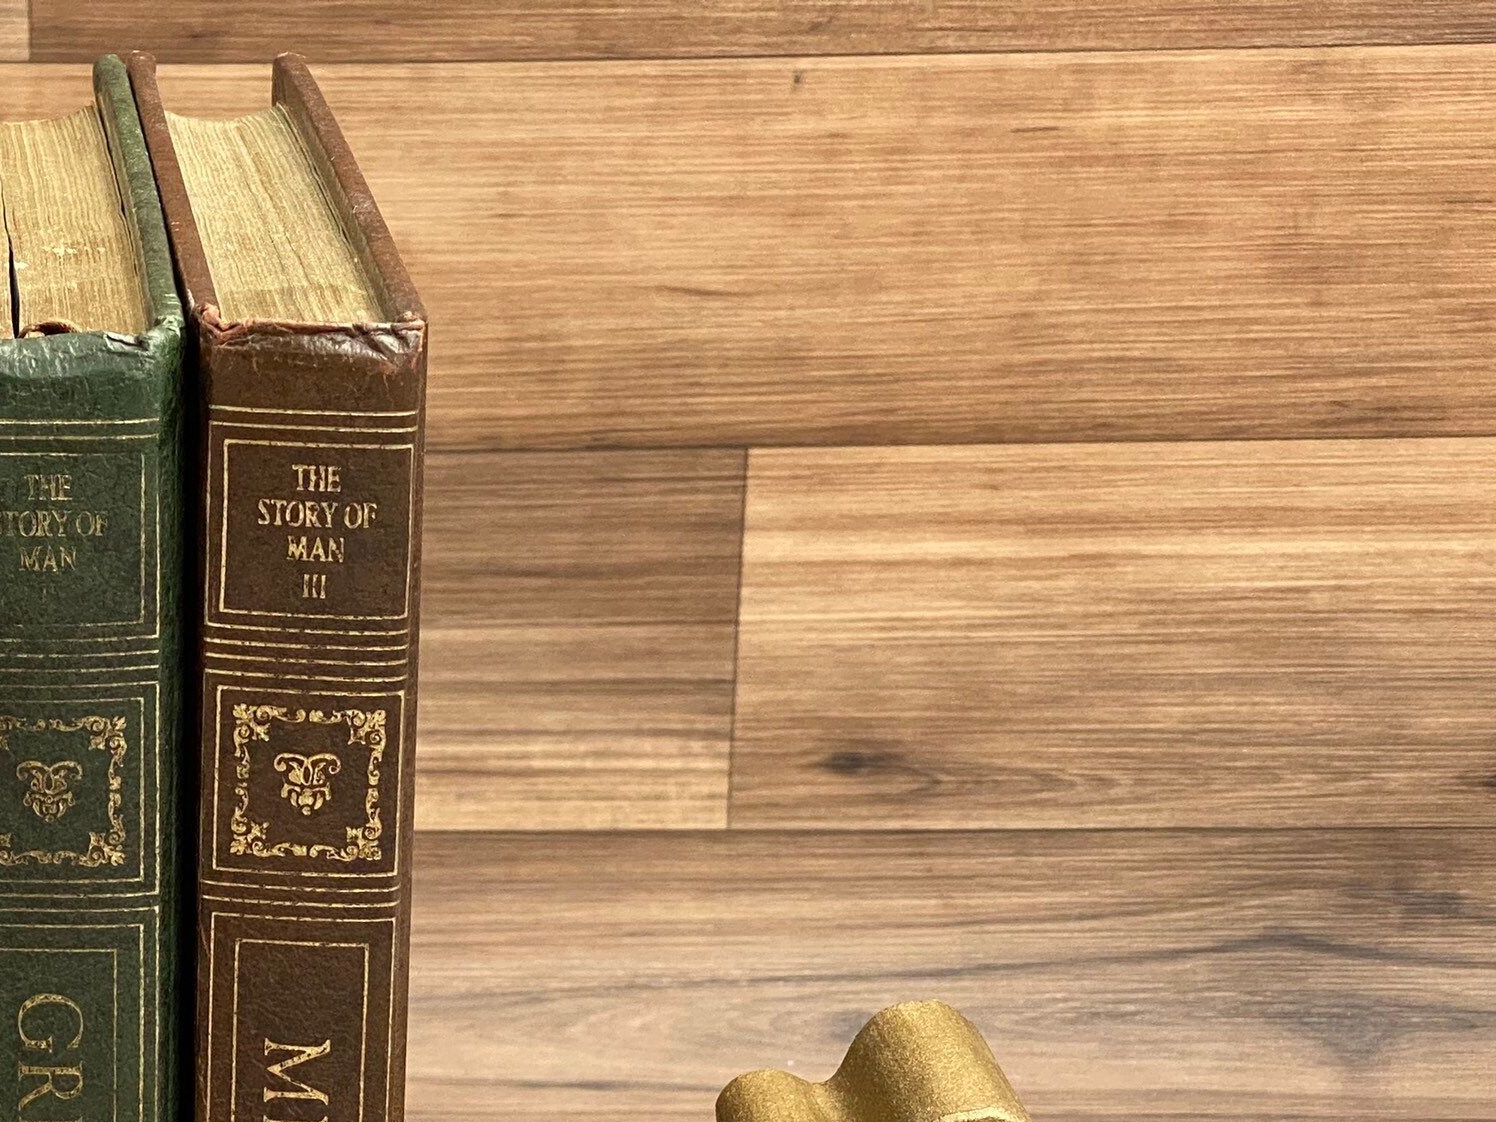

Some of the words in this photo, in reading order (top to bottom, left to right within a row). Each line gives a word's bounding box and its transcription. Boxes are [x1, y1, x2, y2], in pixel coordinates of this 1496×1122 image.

[23, 474, 73, 501] THE
[291, 463, 342, 493] THE
[75, 510, 109, 538] OF
[257, 498, 339, 528] STORY
[343, 501, 378, 529] OF
[18, 544, 78, 573] MAN
[285, 535, 346, 564] MAN
[301, 573, 327, 600] III
